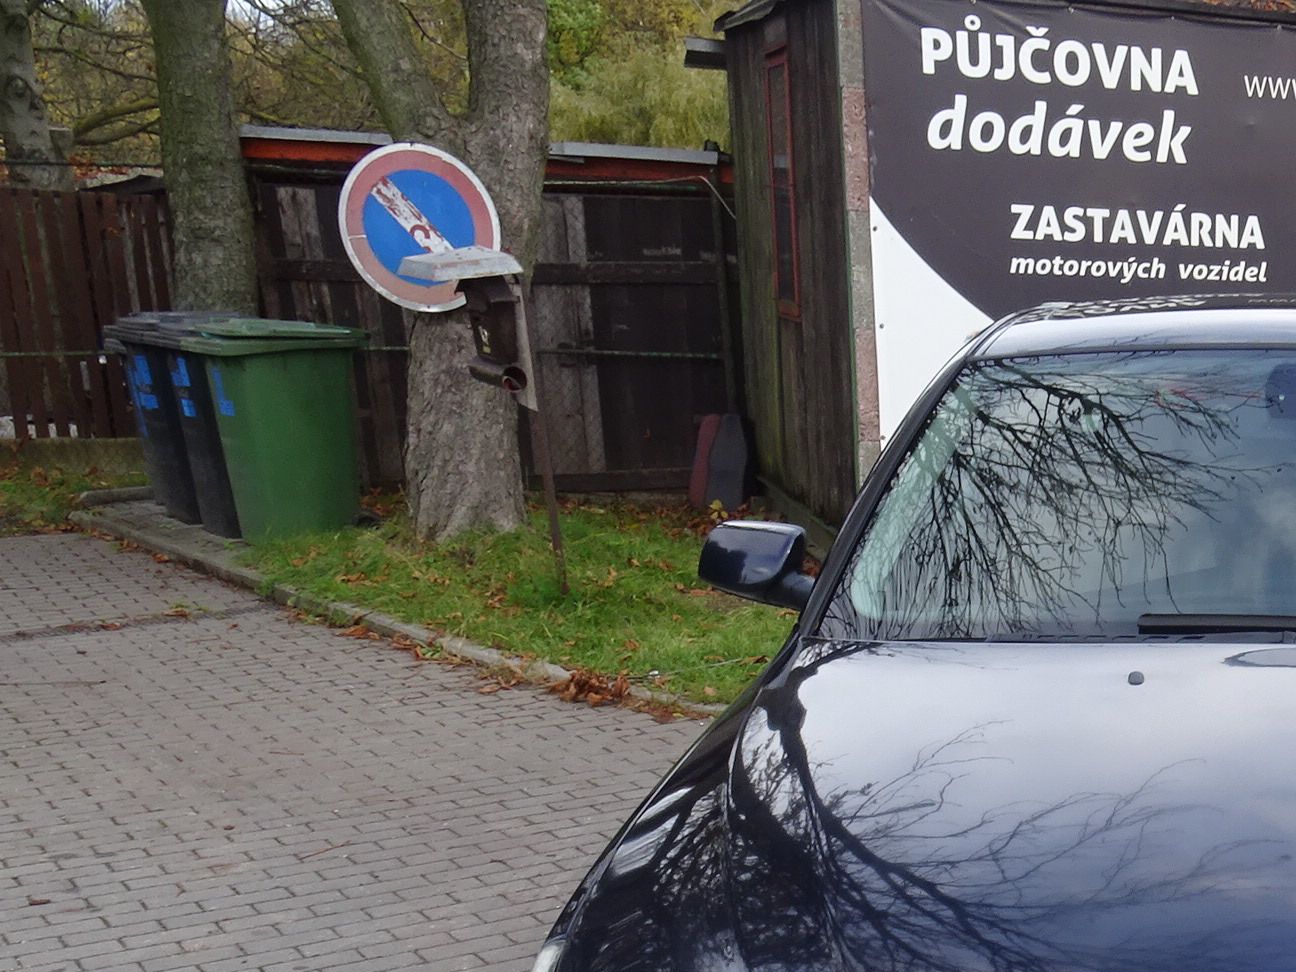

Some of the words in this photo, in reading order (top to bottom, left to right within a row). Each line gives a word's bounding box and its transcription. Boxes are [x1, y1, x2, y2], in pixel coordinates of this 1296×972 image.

[920, 15, 1199, 95] PŮJČOVNA
[927, 94, 1192, 164] dodávek
[1010, 204, 1266, 249] ZASTAVÁRNA
[1010, 256, 1166, 284] motorových
[1179, 261, 1267, 282] vozidel
